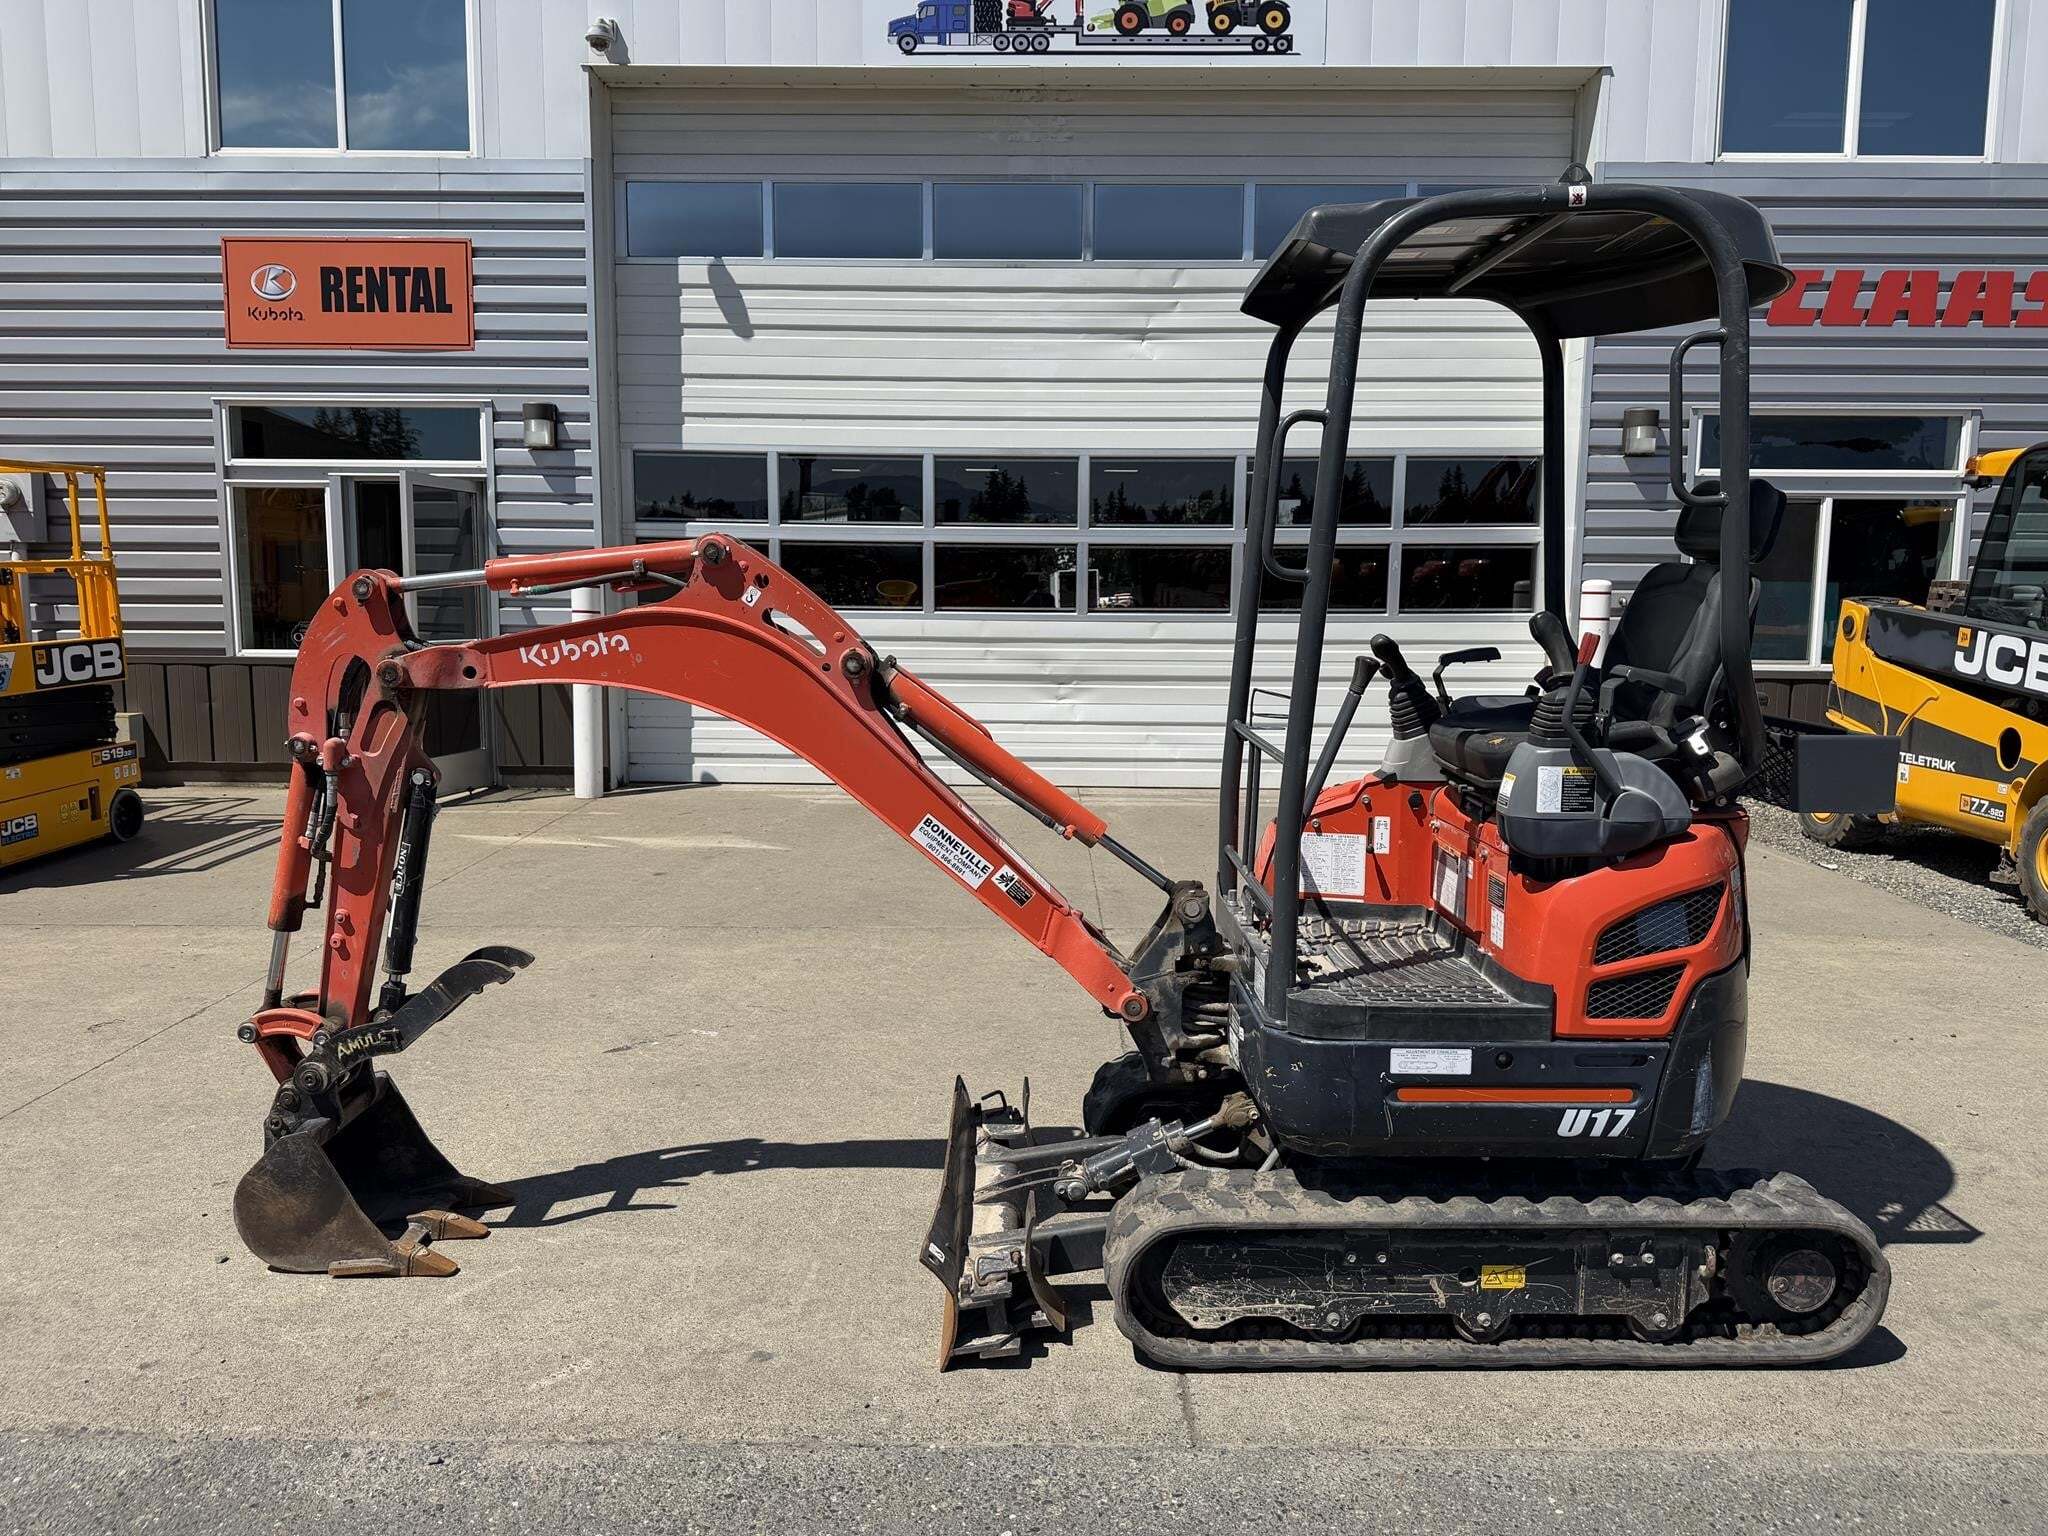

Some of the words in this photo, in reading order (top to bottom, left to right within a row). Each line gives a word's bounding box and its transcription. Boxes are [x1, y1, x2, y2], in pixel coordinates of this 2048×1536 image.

[320, 266, 453, 314] RENTAL
[248, 306, 305, 321] Kubota
[37, 642, 123, 685] JCB
[519, 632, 630, 667] Kubota
[1899, 751, 1957, 772] TELETRUK
[1, 814, 38, 837] JCB
[919, 826, 954, 857] EQUIPMENT
[953, 851, 984, 880] COMPANY
[922, 817, 991, 875] BONNEVILLE
[1557, 1109, 1636, 1137] U17
